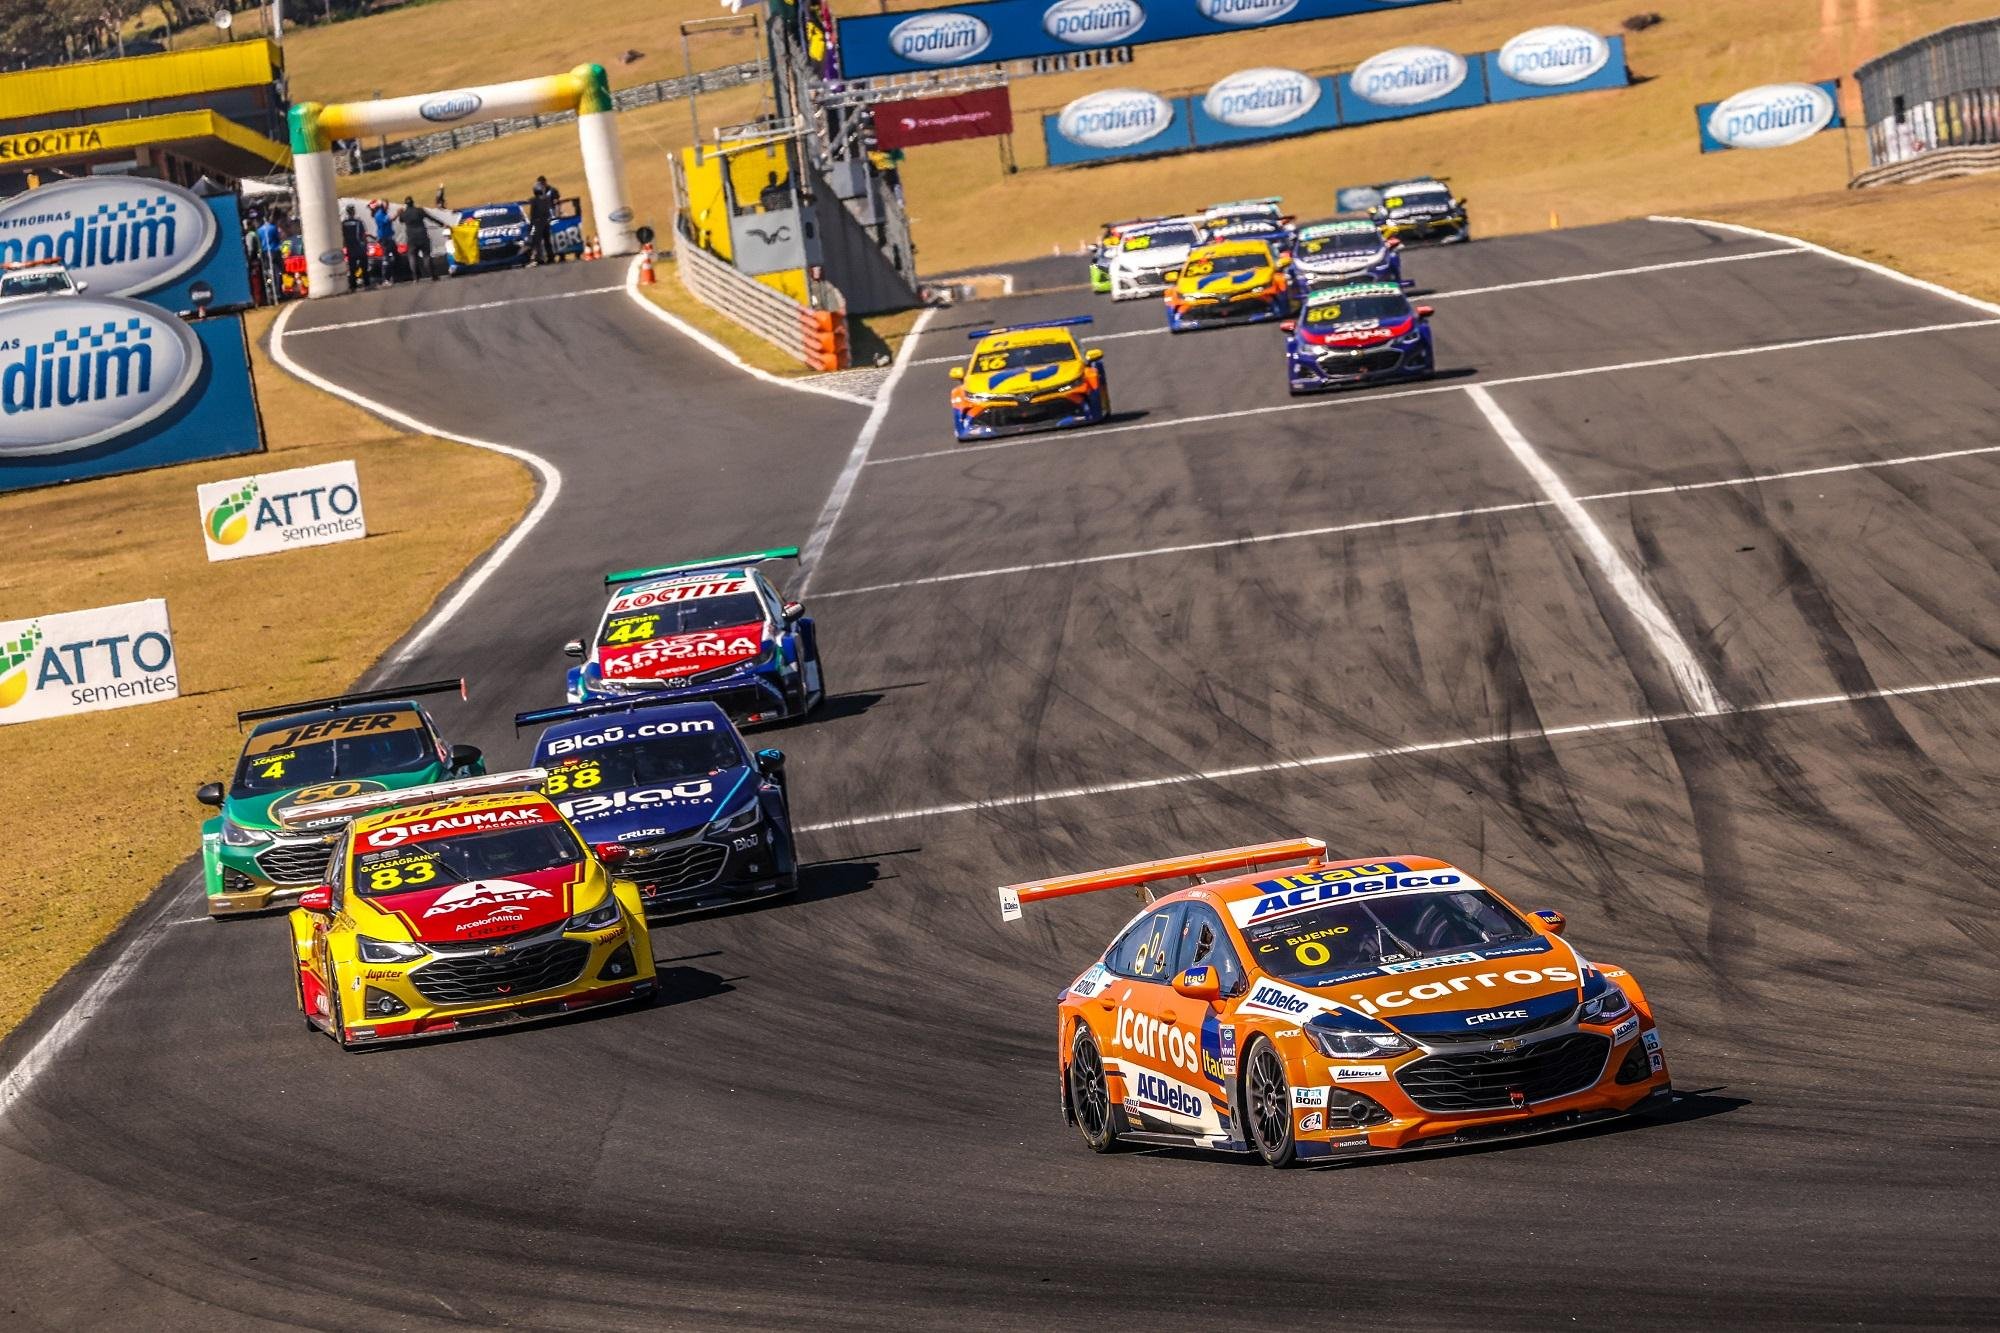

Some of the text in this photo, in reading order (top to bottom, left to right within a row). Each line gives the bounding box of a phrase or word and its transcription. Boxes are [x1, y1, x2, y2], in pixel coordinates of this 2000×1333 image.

[1056, 8, 1131, 35] podium
[902, 28, 977, 53] podium
[1514, 45, 1592, 75] podium
[1368, 63, 1449, 97] podium
[427, 98, 474, 118] podium
[1221, 86, 1302, 120] podium
[1076, 105, 1156, 137] podium
[1727, 103, 1814, 140] podium
[254, 483, 358, 531] ATTO
[282, 516, 363, 542] sementes
[612, 580, 747, 612] LOCTITE
[607, 621, 656, 642] 44
[36, 631, 172, 691] ATTO
[604, 637, 757, 671] KRONA
[605, 659, 653, 677] TUBOS
[71, 674, 178, 706] sementes
[268, 714, 397, 752] JEFER
[260, 761, 285, 778] 4
[293, 781, 362, 805] 50
[306, 815, 353, 829] CRUZE
[410, 808, 543, 836] RAUMAK
[477, 818, 545, 831] PACKAGING
[617, 828, 667, 841] CRUZE
[370, 862, 436, 891] 83
[1270, 862, 1394, 891] Itaú
[422, 889, 554, 919] AXALTA
[1252, 874, 1461, 917] ACDelco
[456, 914, 524, 932] ArcelorMittal
[467, 925, 519, 938] CRUZE
[599, 927, 627, 946] Jupiter
[1259, 944, 1280, 954] C.
[1286, 926, 1350, 946] BUENO
[1295, 941, 1331, 966] 0
[365, 969, 404, 981] Jupiter
[1184, 973, 1206, 985] Itaú
[1252, 986, 1309, 1013] ACDelco
[1350, 966, 1578, 1016] icarros
[1465, 1009, 1529, 1026] CRUZE
[1203, 1049, 1225, 1081] Itaú
[1137, 1072, 1202, 1117] ACDelco
[1295, 1096, 1322, 1105] BOND
